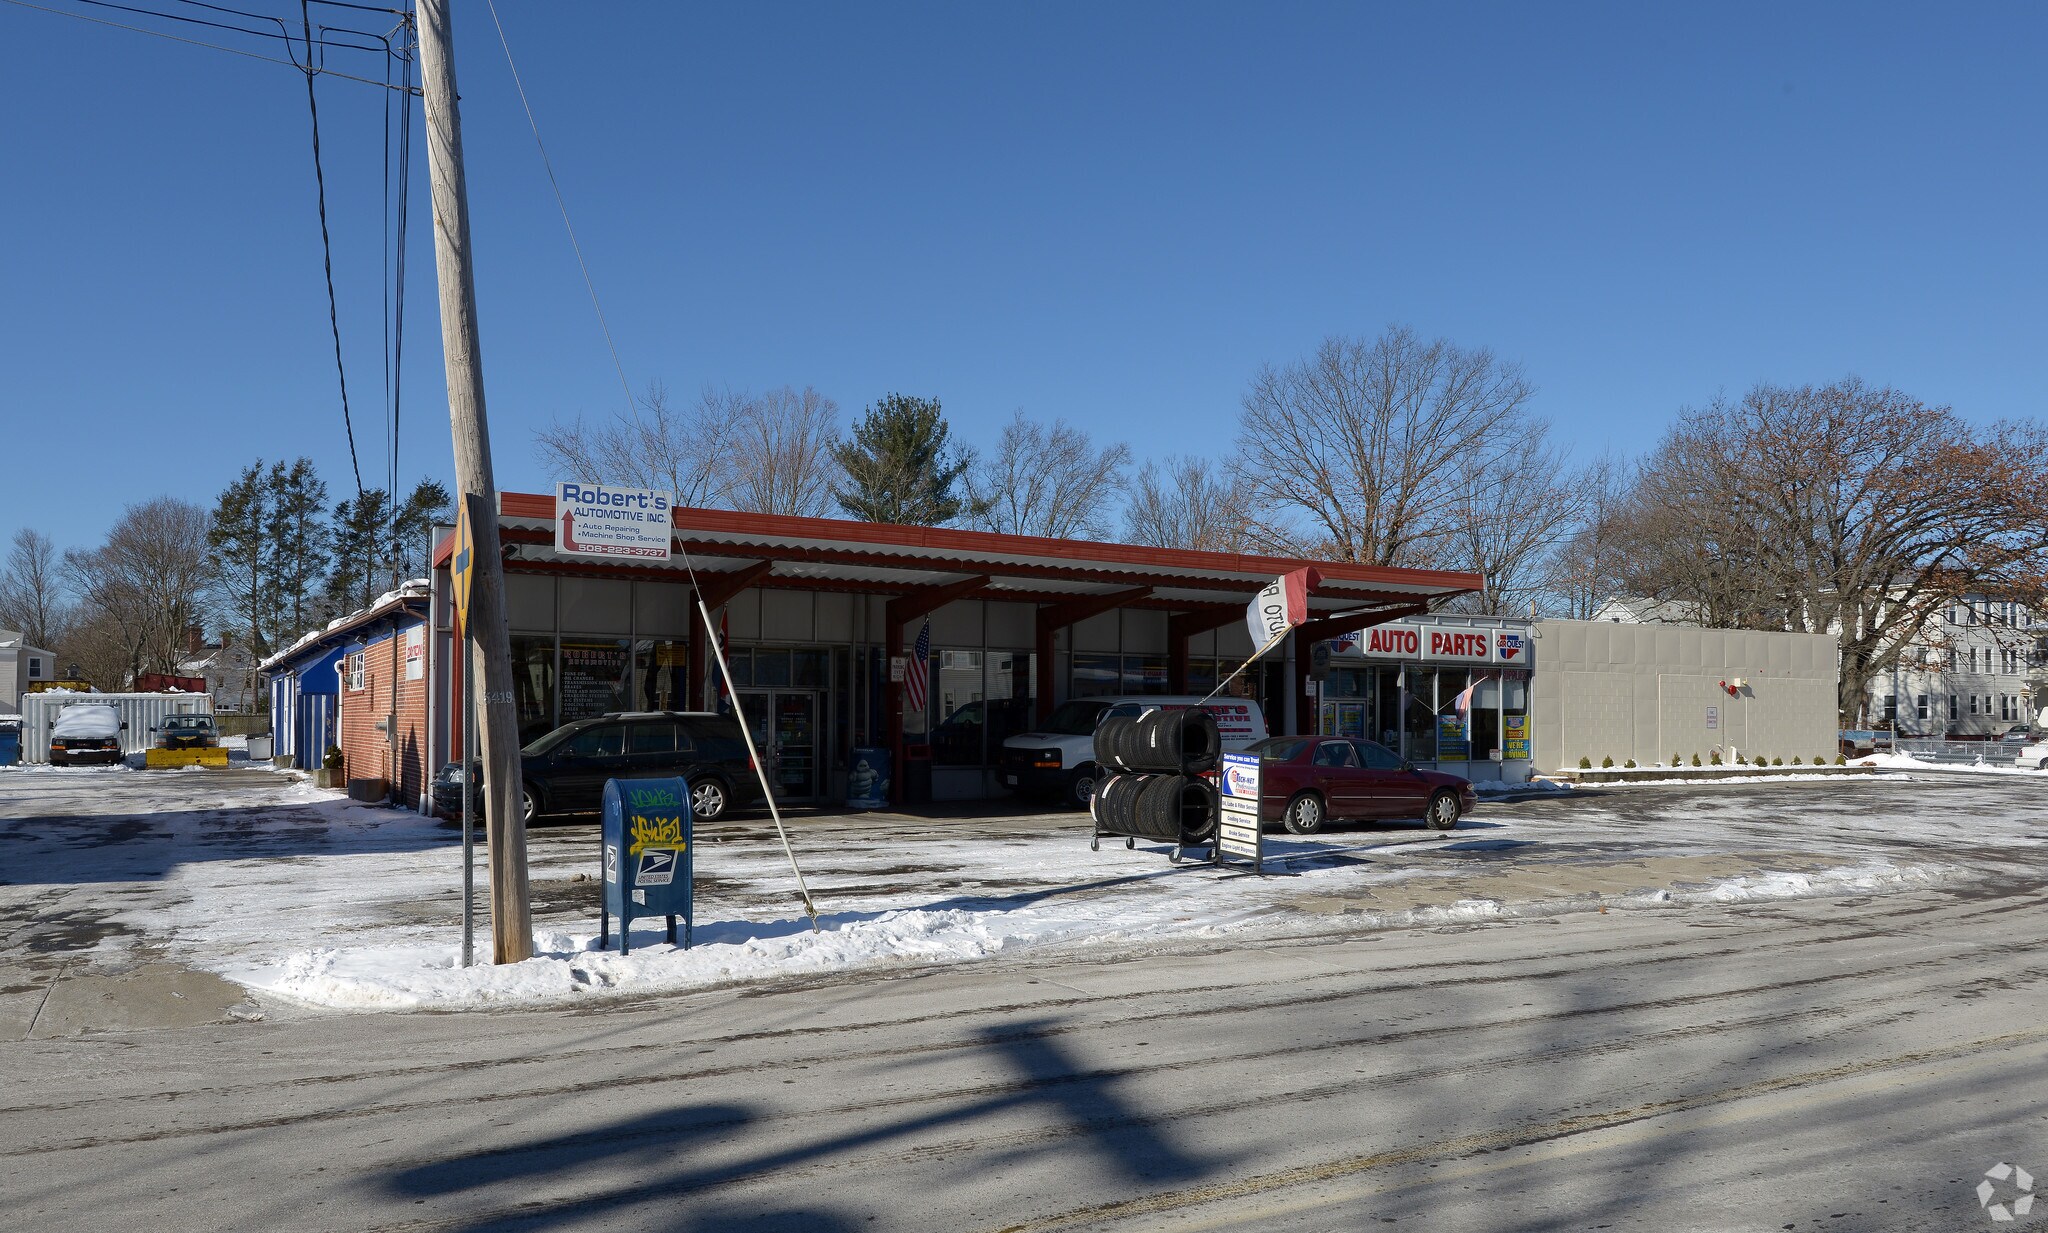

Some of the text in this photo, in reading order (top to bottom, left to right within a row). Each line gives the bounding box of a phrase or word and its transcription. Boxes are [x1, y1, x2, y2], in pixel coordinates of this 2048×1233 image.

[562, 483, 667, 510] Robert's
[574, 507, 666, 523] AUTOMOTIVE INC.
[605, 524, 640, 534] Repairing
[582, 531, 666, 543] Machine Shop Service
[578, 544, 665, 557] 508-223-3737
[1368, 628, 1487, 657] AUTO PARTS
[563, 650, 627, 660] ROBERT'S
[1223, 753, 1237, 761] Service
[1238, 831, 1250, 839] Service
